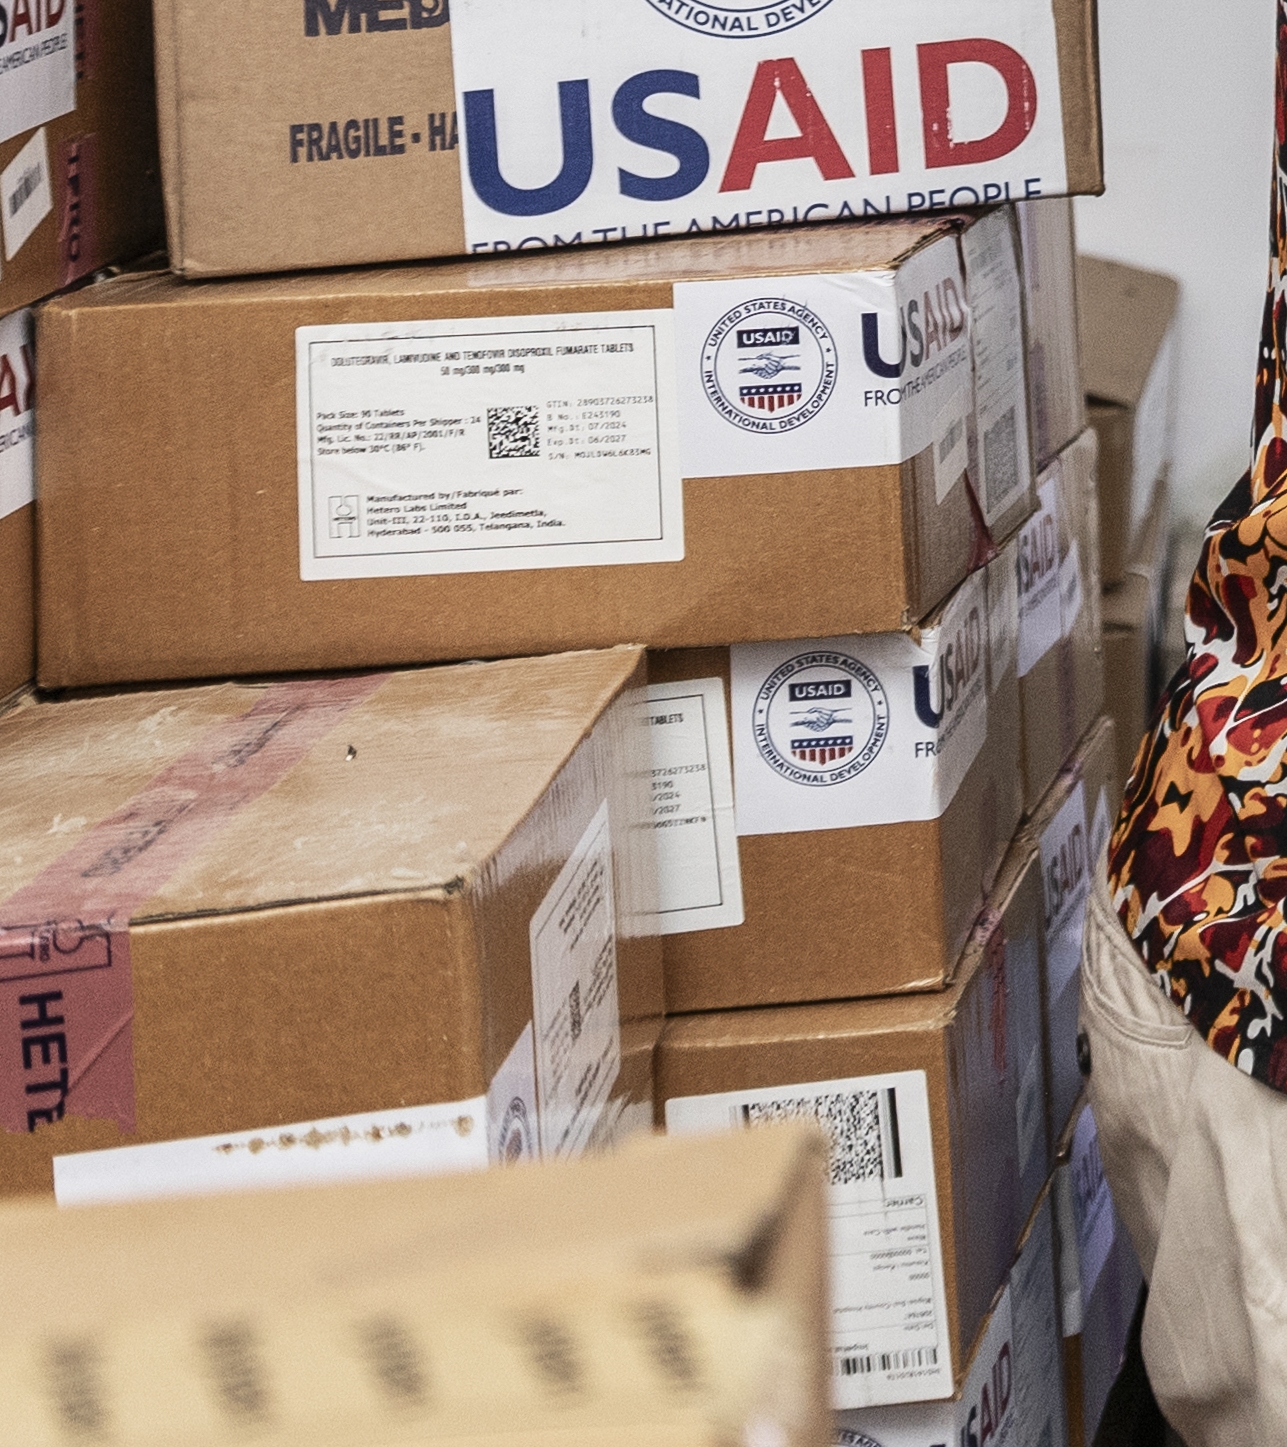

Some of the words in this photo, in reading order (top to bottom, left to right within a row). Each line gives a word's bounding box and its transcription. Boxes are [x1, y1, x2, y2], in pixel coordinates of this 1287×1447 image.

[290, 115, 406, 163] FRAGILE
[462, 37, 1038, 217] USAID
[708, 310, 742, 348] UNITED
[744, 301, 786, 313] STATES
[787, 304, 829, 340] AGENCY
[742, 330, 796, 344] USAID
[861, 277, 964, 379] USAID
[444, 351, 460, 361] AND
[463, 349, 505, 361] TENOFOVIR
[556, 344, 598, 356] FUMARATE
[601, 343, 634, 353] TABLETS
[704, 370, 776, 431] INTERNATIONAL
[779, 361, 835, 430] DEVELOPMENT
[365, 420, 410, 430] Containers
[367, 493, 435, 503] Manufactured
[367, 506, 400, 515] Hetero
[403, 504, 427, 513] Labs
[429, 502, 467, 512] Limited
[367, 527, 421, 538] Hyderabad
[760, 664, 794, 701] UNITED
[796, 654, 840, 667] STATES
[840, 657, 881, 693] AGENCY
[912, 606, 979, 729] USAID
[794, 684, 845, 698] USAID
[651, 713, 684, 726] TABLETS
[755, 724, 827, 783] INTERNATIONAL
[830, 714, 886, 782] DEVELOPMENT
